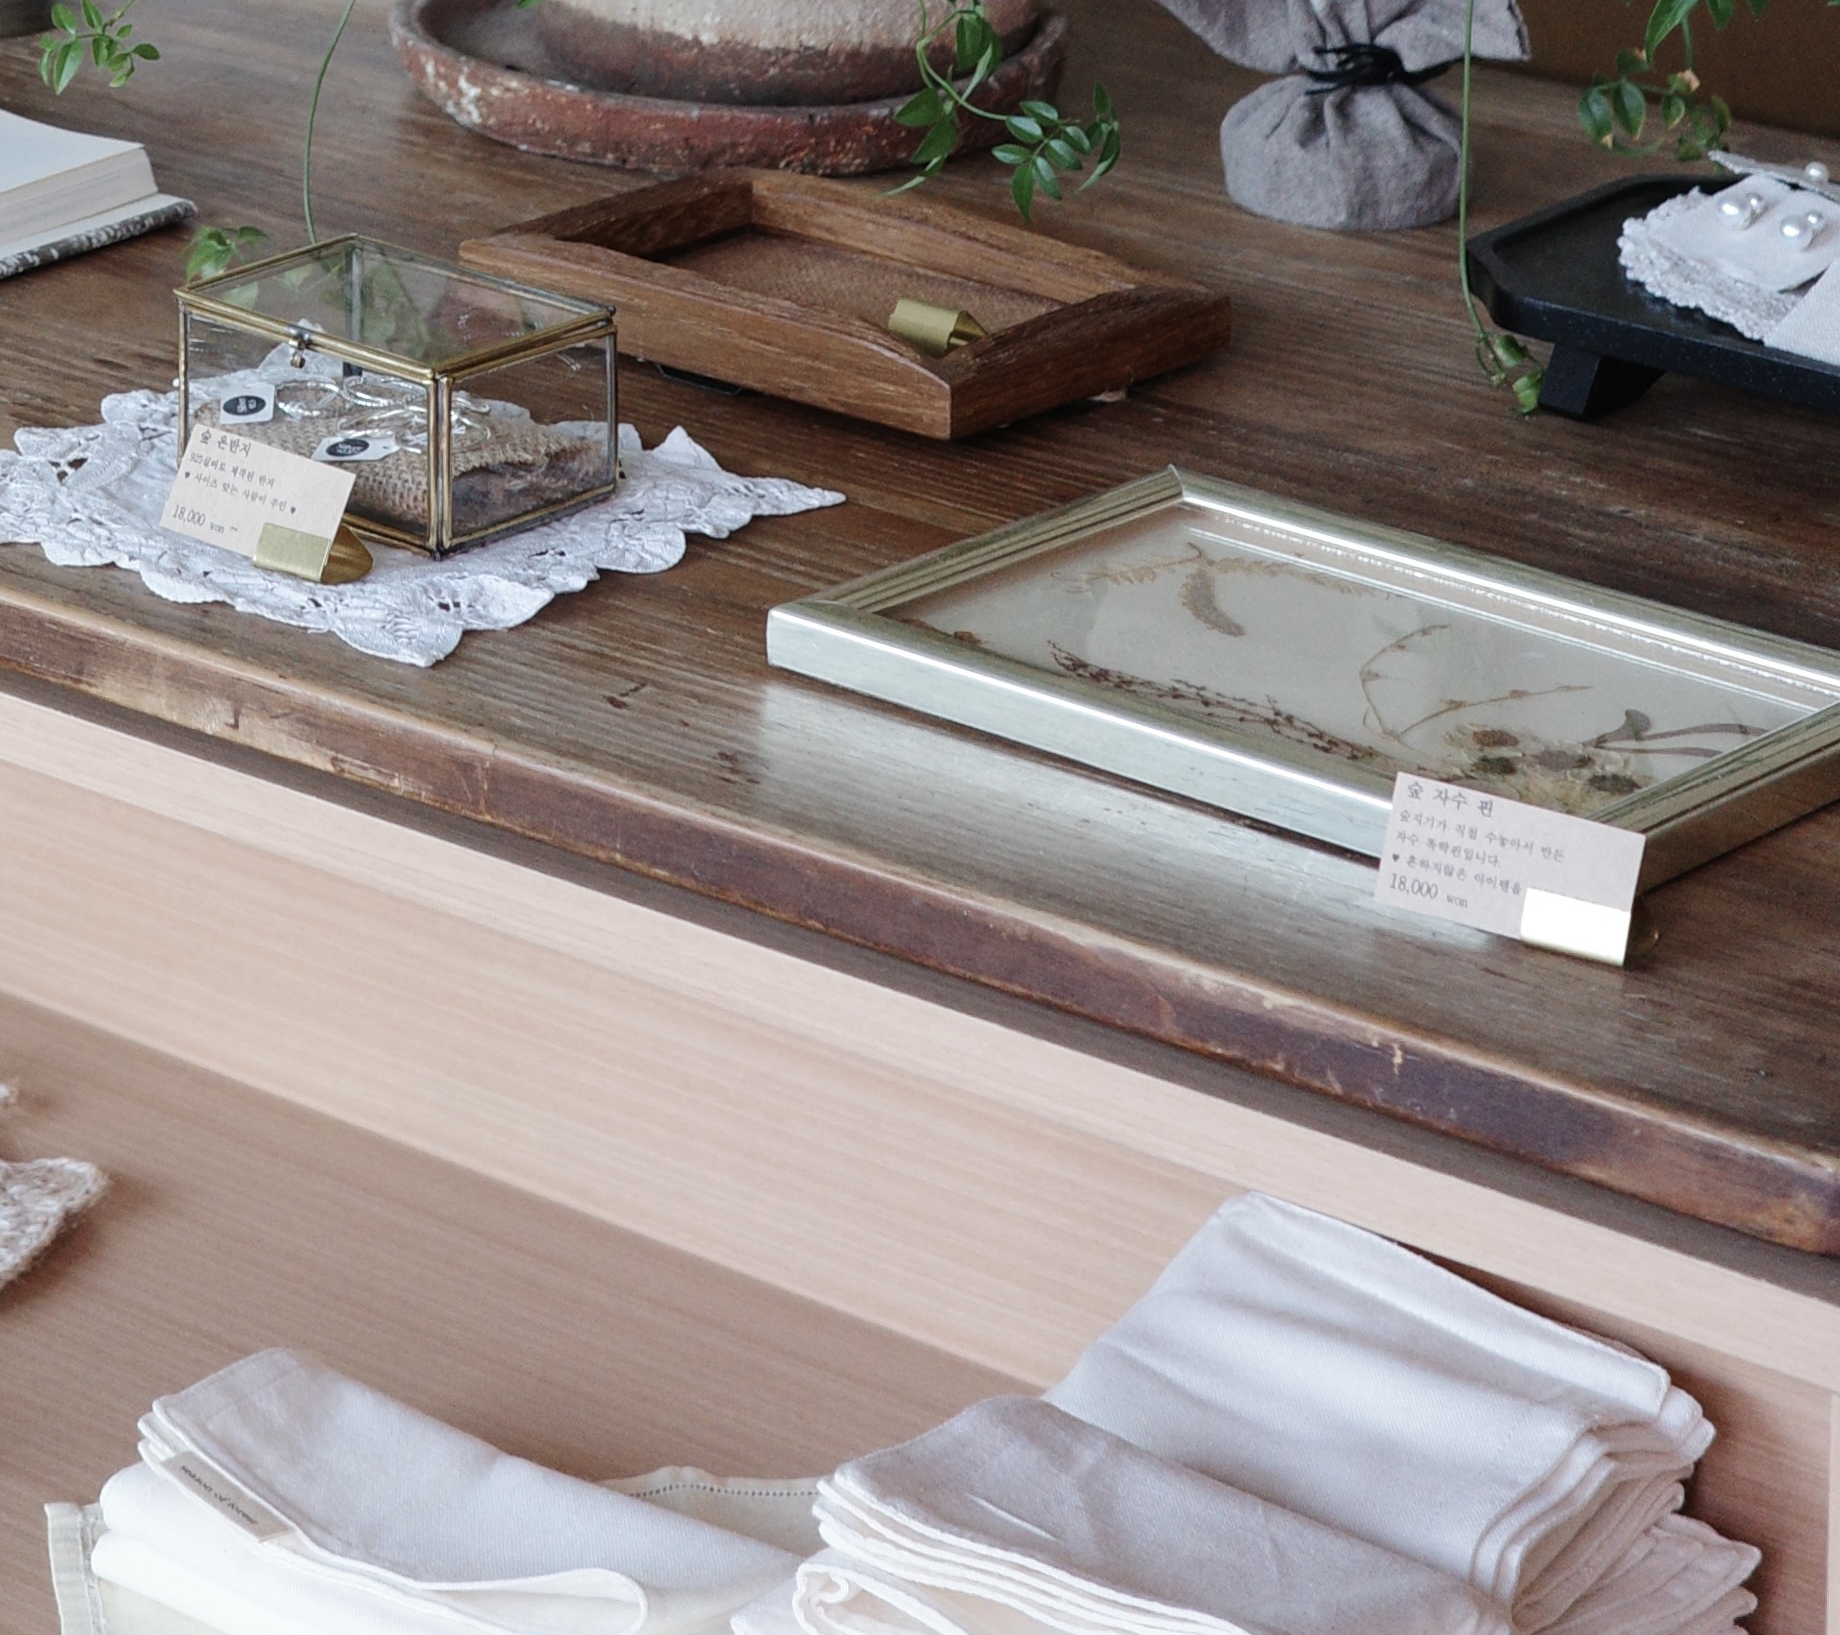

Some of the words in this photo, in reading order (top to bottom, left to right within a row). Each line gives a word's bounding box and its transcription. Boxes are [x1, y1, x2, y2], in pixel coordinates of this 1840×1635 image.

[217, 435, 252, 458] 은반지
[172, 504, 207, 527] 18,000
[1407, 781, 1423, 800] 숲
[1432, 787, 1468, 811] 자수
[1477, 800, 1494, 818] 핀
[1396, 830, 1419, 846] 자수
[1455, 823, 1479, 841] 직접
[1541, 846, 1565, 863] 만든
[1390, 872, 1439, 900] 18,000
